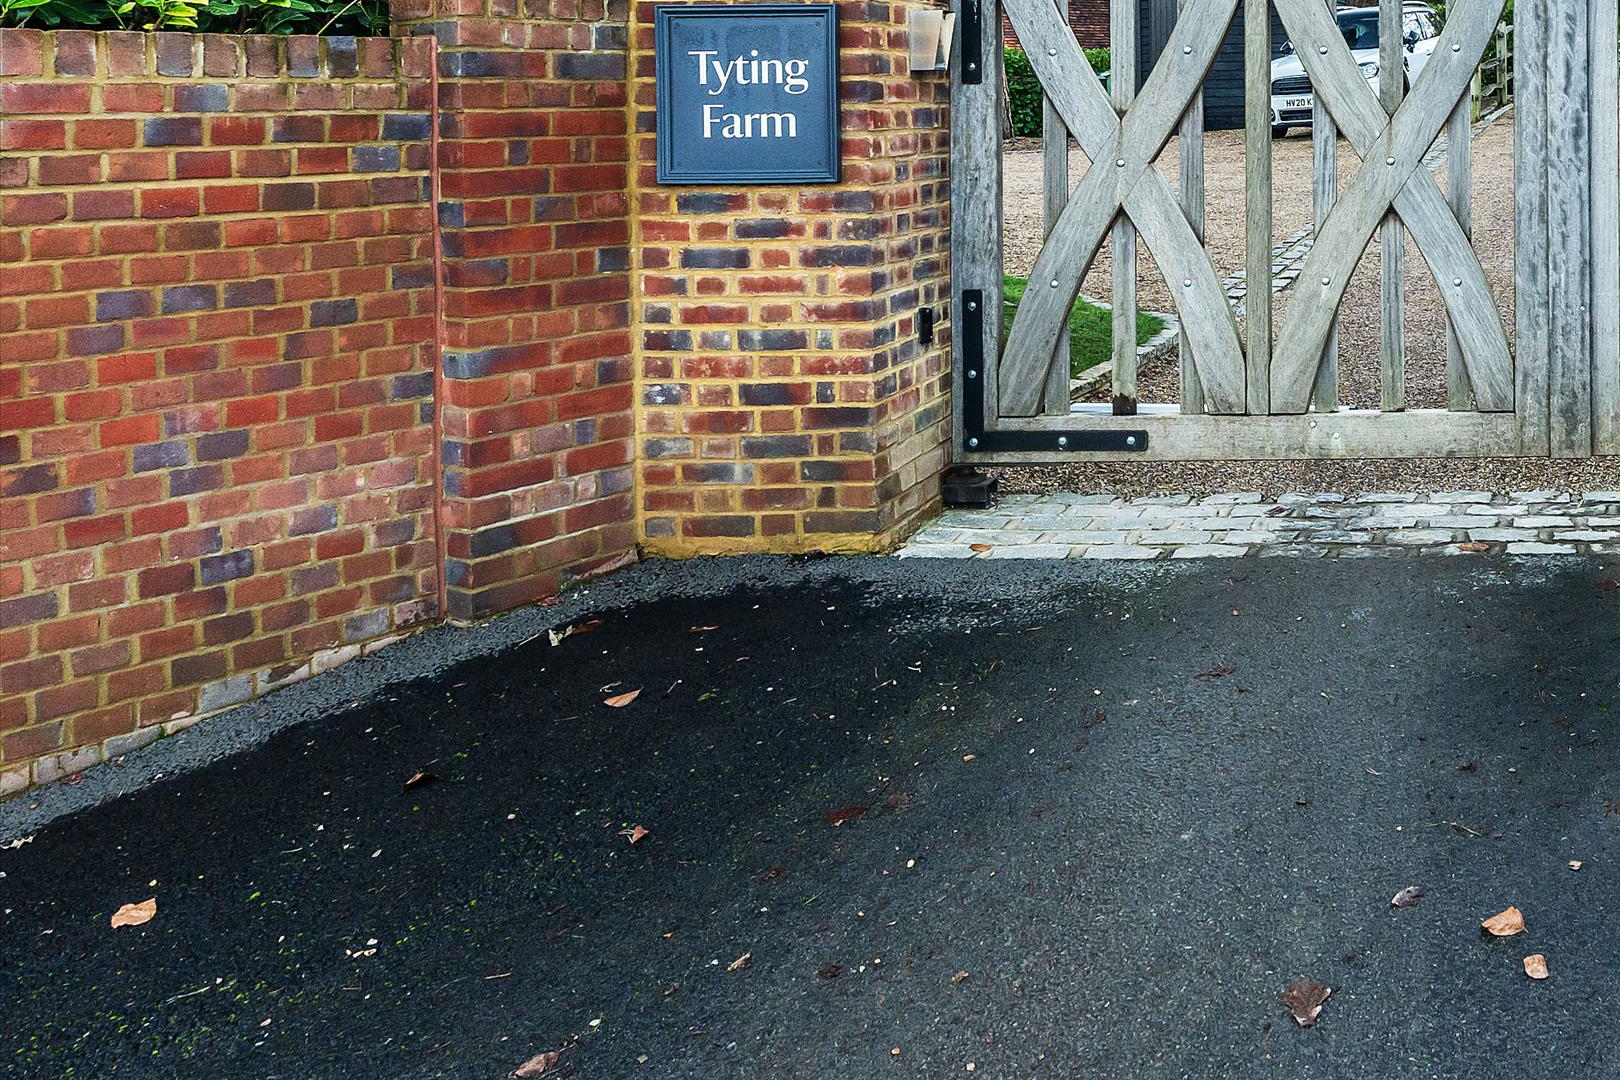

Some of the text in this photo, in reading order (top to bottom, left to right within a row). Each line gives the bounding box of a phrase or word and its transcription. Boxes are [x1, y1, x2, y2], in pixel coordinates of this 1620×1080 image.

[687, 49, 809, 95] Tyting
[1286, 98, 1306, 107] HV20
[702, 104, 797, 138] Farm
